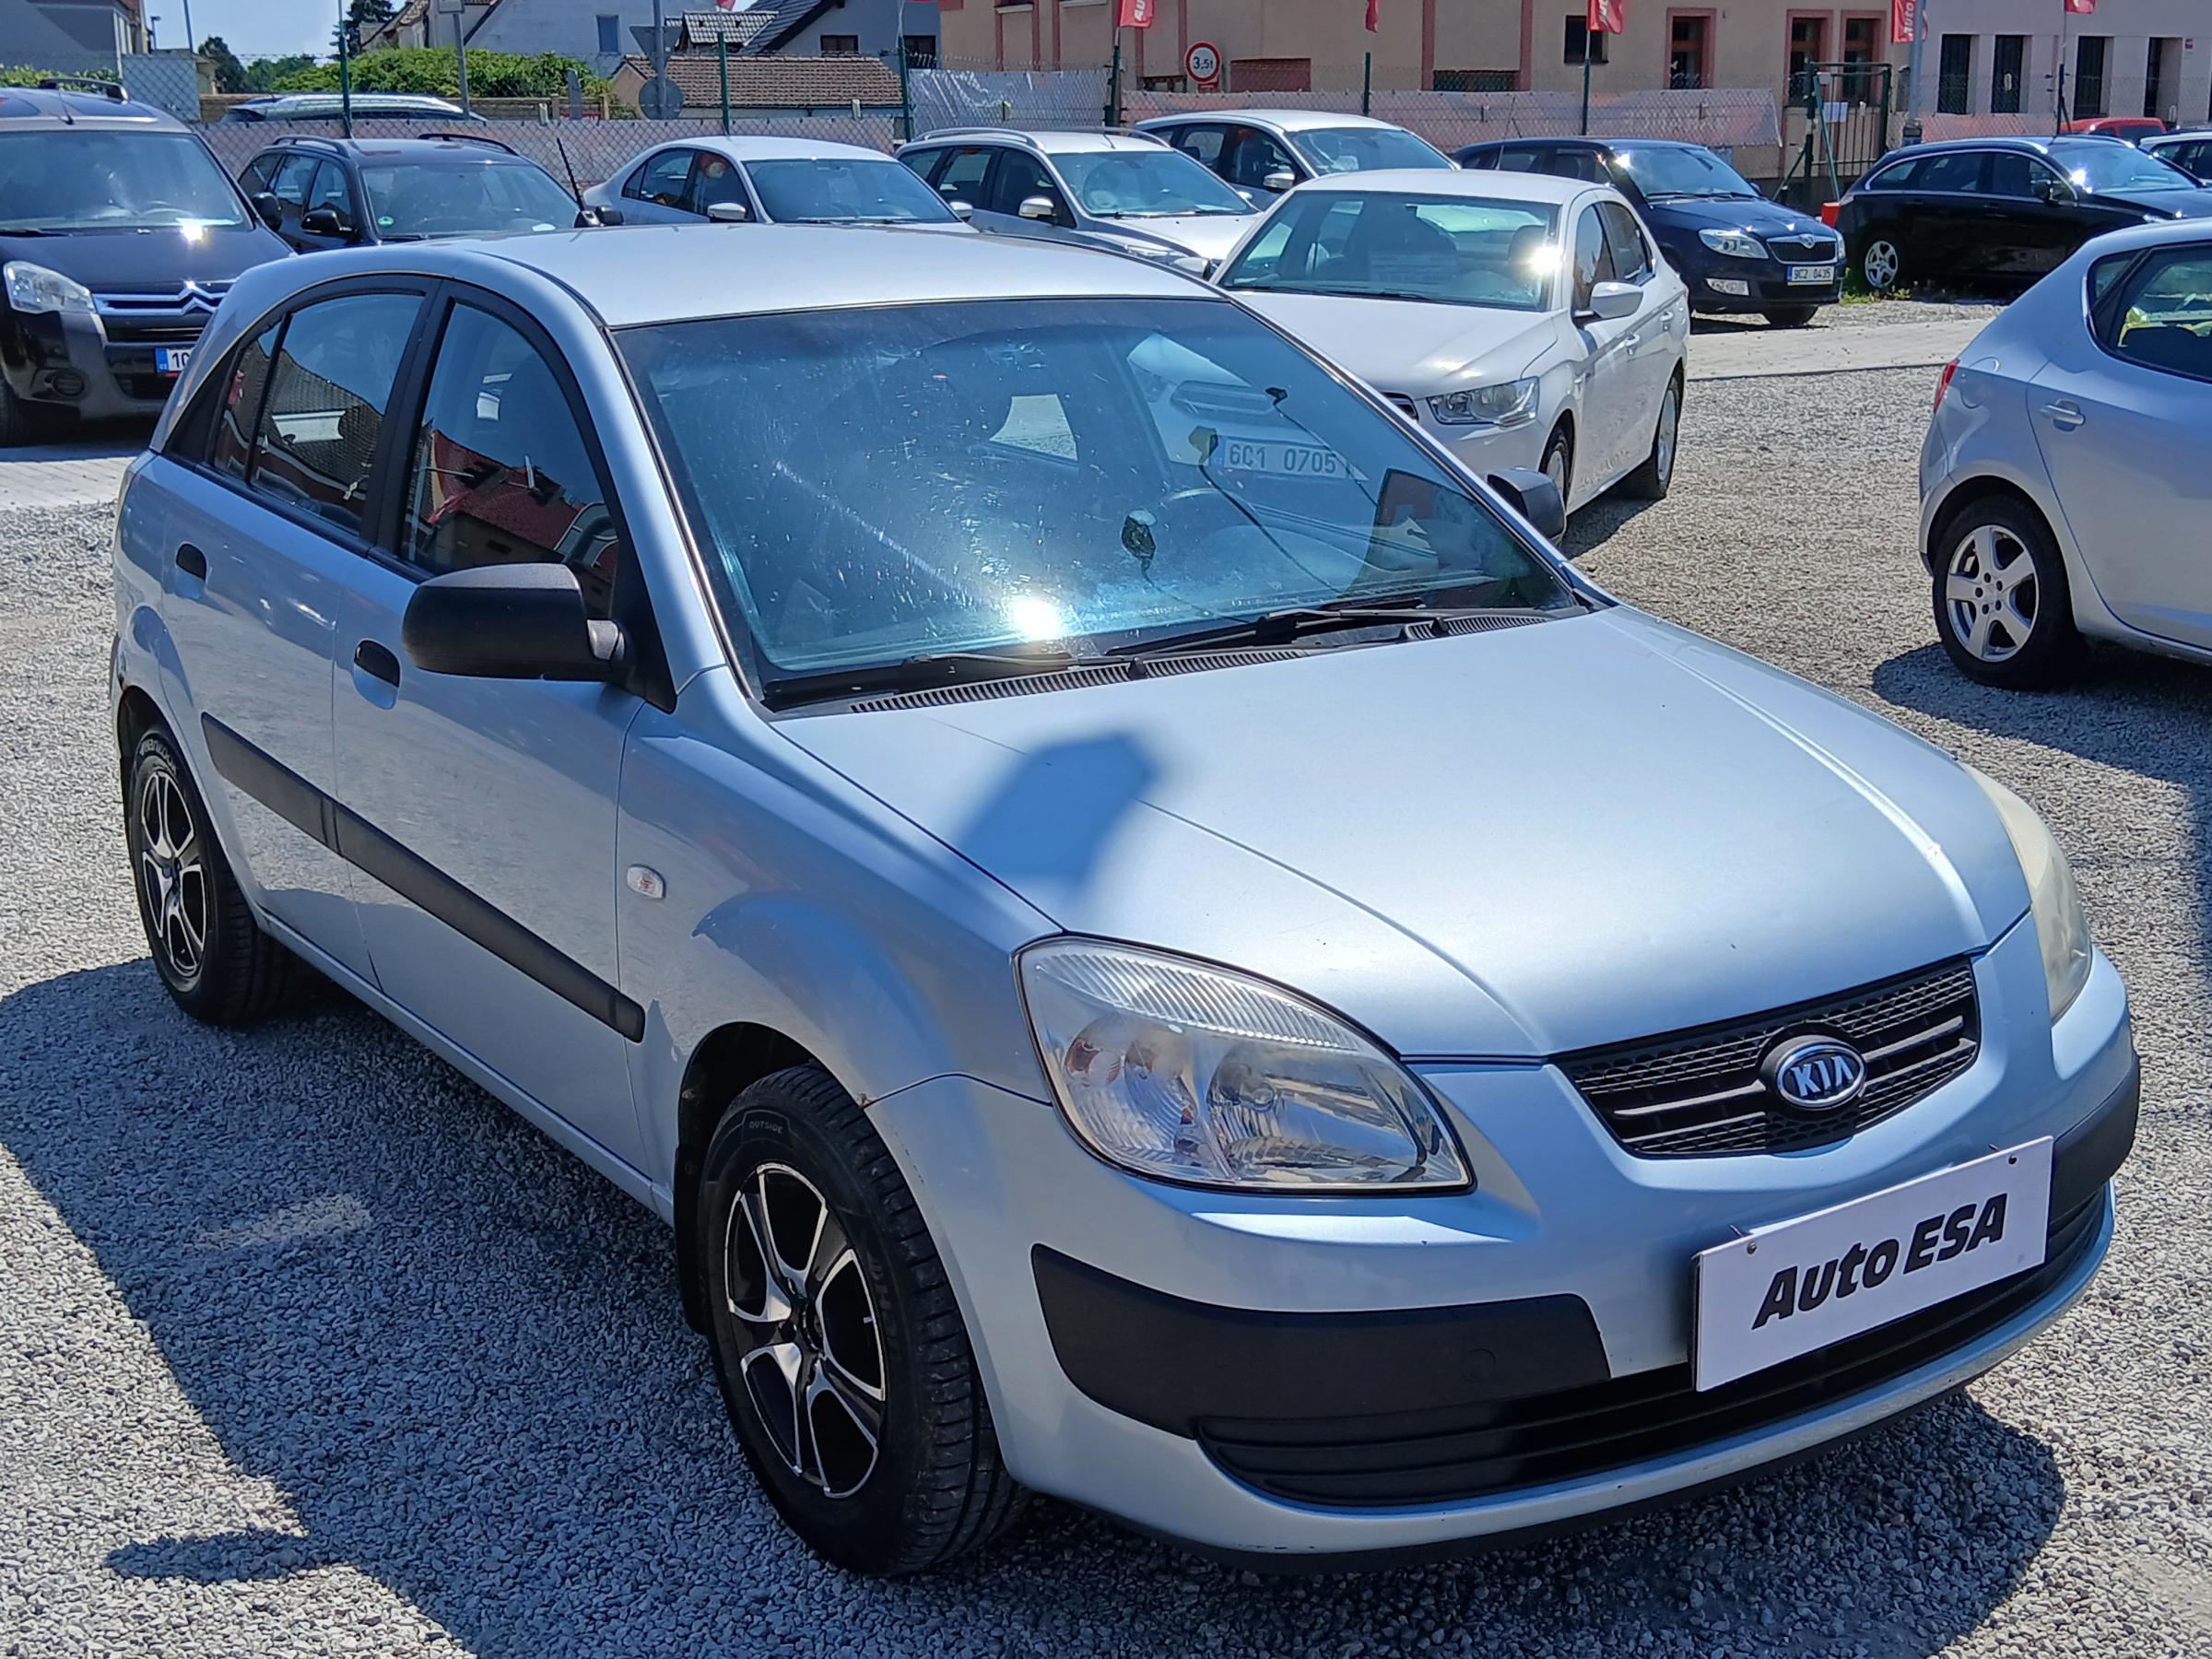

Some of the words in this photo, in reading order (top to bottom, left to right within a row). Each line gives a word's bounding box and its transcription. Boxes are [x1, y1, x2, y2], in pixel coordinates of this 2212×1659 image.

[1230, 443, 1266, 468] 6C1
[1284, 448, 1336, 474] 0705
[1790, 1055, 1854, 1098] KIA
[748, 1120, 782, 1134] OUTSIDE
[1751, 1239, 1900, 1330] Auto
[1903, 1193, 2007, 1275] ESA
